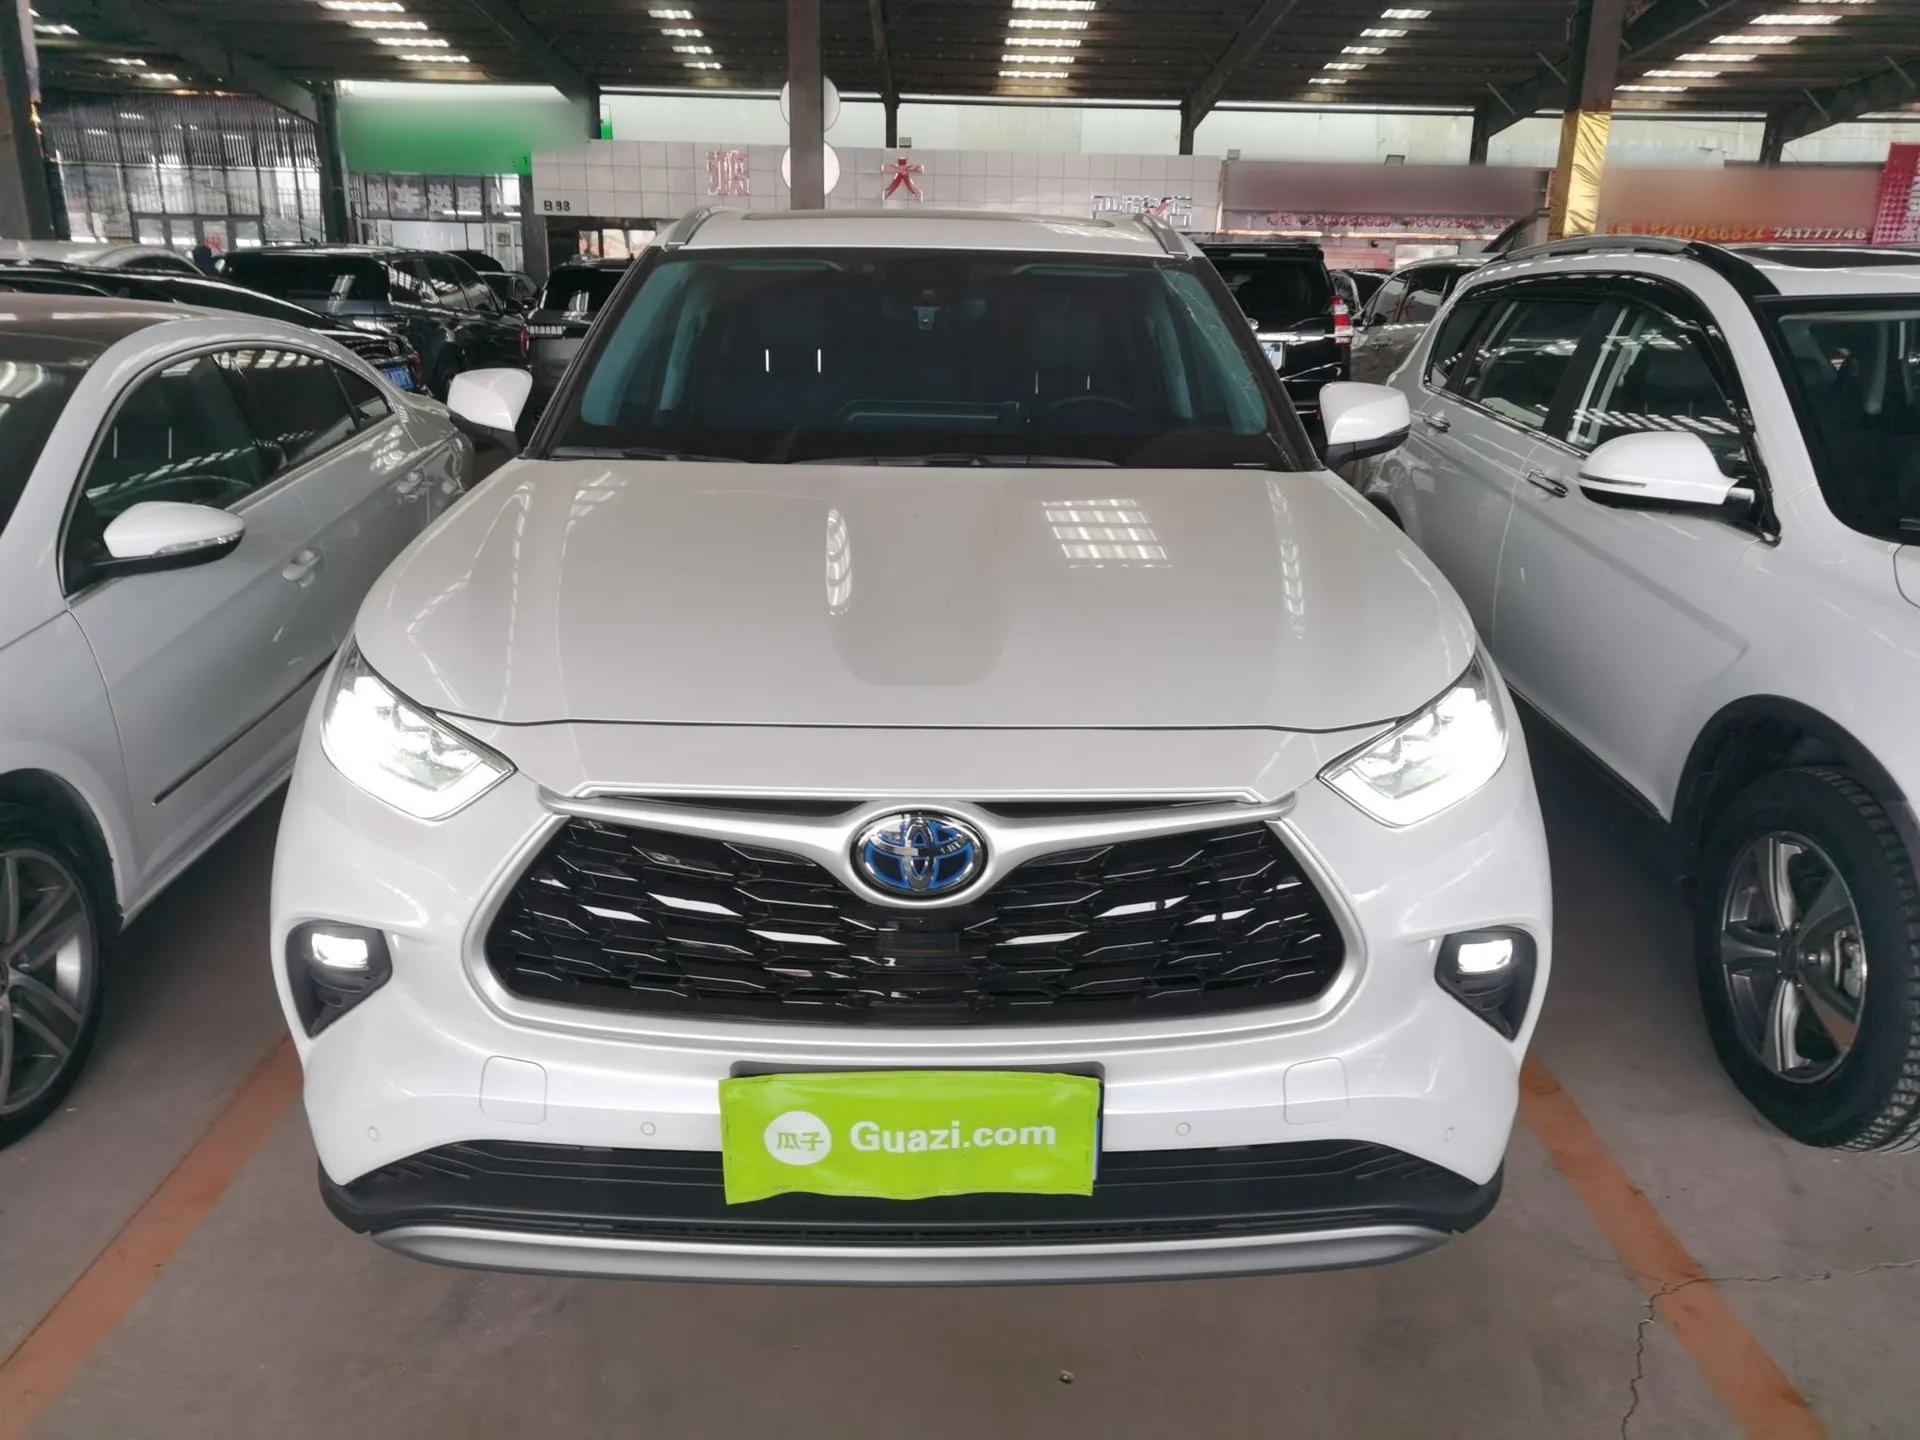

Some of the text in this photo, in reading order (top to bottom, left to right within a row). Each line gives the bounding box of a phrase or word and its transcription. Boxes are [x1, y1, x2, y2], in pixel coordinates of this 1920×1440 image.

[882, 157, 924, 203] 大
[776, 1120, 1057, 1154] 瓜子 Guazi.com
